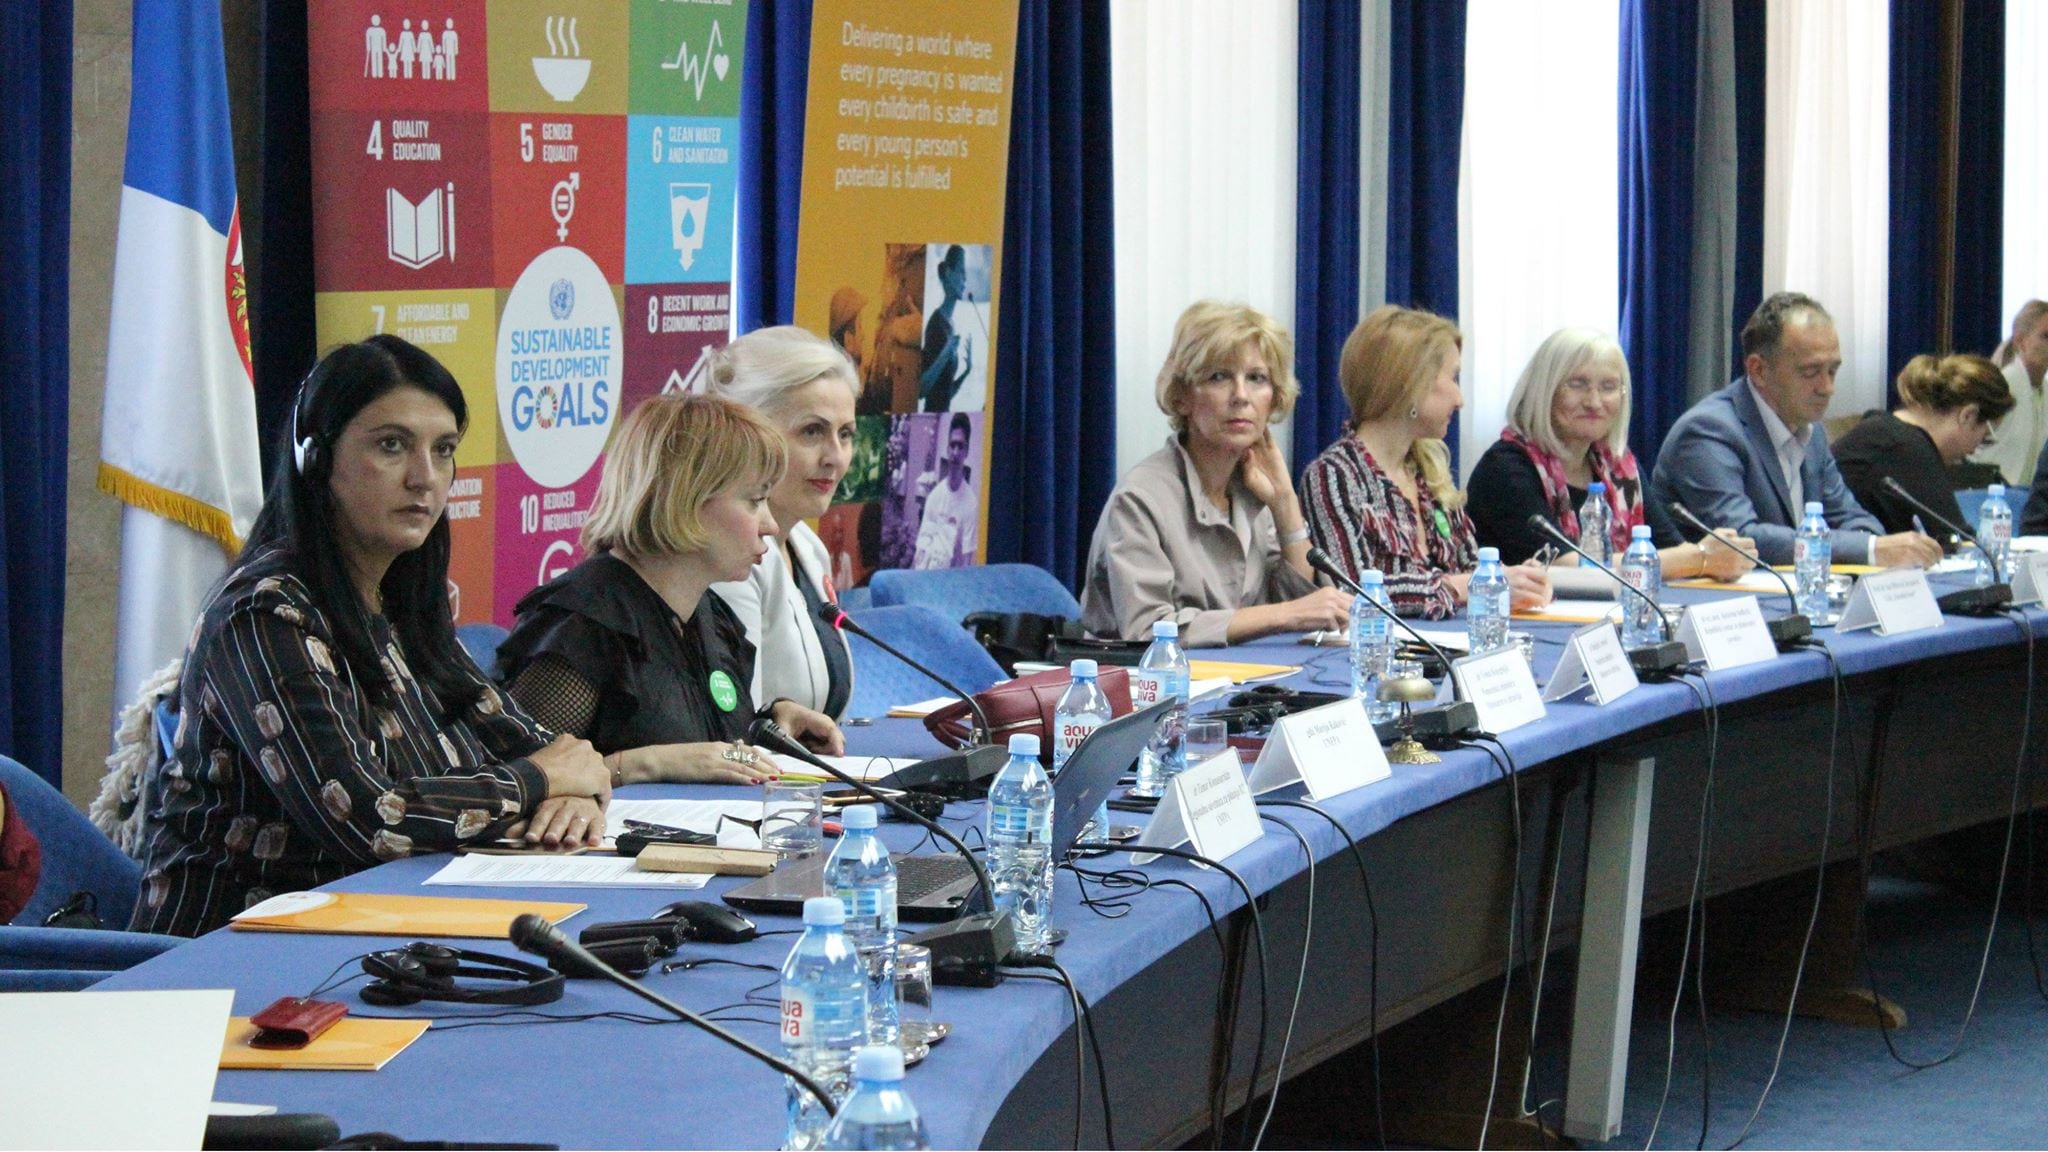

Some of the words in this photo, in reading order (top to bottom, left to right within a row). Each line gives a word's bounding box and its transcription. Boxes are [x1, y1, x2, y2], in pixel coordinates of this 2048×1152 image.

[841, 21, 904, 57] Delivering
[905, 35, 914, 52] a
[916, 32, 950, 56] world
[954, 34, 993, 60] where
[840, 63, 873, 88] every
[876, 66, 940, 94] pregnancy
[944, 66, 954, 90] is
[959, 70, 1003, 93] wanted
[838, 97, 871, 122] every
[874, 95, 931, 121] childbirth
[934, 100, 944, 122] is
[947, 101, 973, 124] safe
[976, 104, 998, 126] and
[366, 120, 384, 161] 4
[393, 120, 429, 139] QUALITY
[393, 143, 441, 161] EDUCATION
[520, 123, 534, 162] 5
[542, 123, 573, 140] GENDER
[543, 145, 578, 163] EQUALITY
[653, 126, 663, 163] 6
[668, 126, 694, 142] CLEAN
[695, 127, 721, 144] WATER
[837, 132, 869, 157] every
[872, 134, 912, 159] young
[914, 135, 968, 157] person's
[668, 147, 683, 163] AND
[684, 147, 728, 164] SANITATION
[835, 163, 889, 191] potential
[891, 166, 901, 188] is
[905, 163, 951, 190] fulfilled
[371, 305, 385, 336] 7
[397, 303, 450, 322] AFFORDABLE
[451, 303, 470, 320] AND
[648, 296, 659, 333] 8
[662, 295, 692, 312] DECENT
[692, 295, 716, 311] WORK
[662, 315, 702, 333] ECONOMIC
[425, 326, 458, 343] ENERGY
[511, 326, 611, 354] SUSTAINABLE
[511, 355, 610, 382] DEVELOPMENT
[511, 380, 609, 432] GOALS
[448, 478, 483, 498] OVATION
[520, 494, 539, 534] 10
[543, 490, 576, 510] REDUCED
